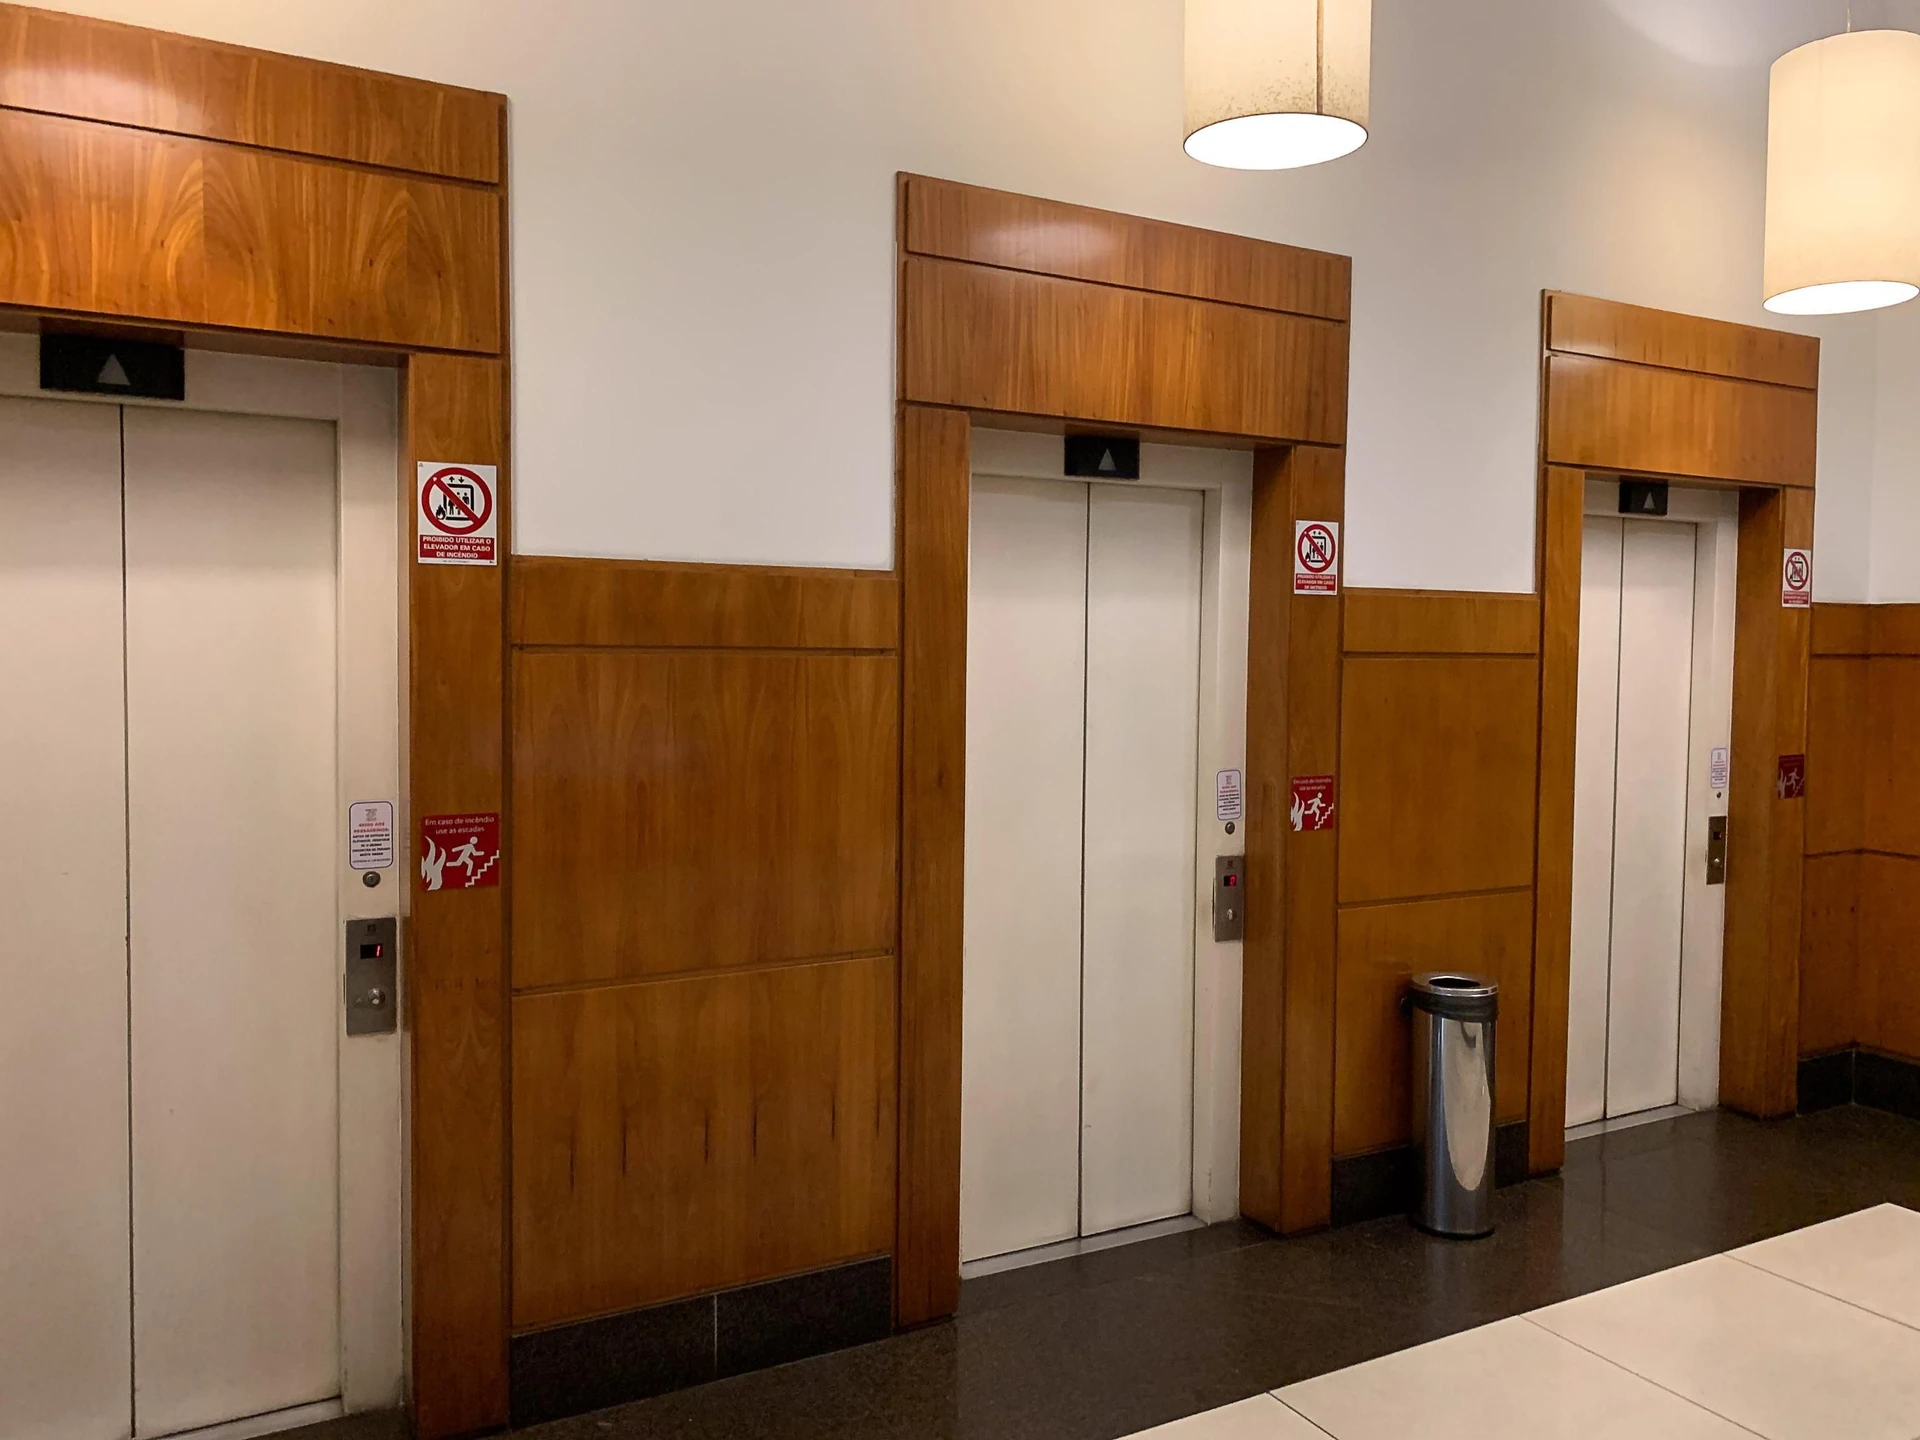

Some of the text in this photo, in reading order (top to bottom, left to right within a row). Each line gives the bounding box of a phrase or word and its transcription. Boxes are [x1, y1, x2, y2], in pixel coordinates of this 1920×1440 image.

[423, 543, 459, 551] ELEVADOR
[446, 551, 478, 559] INCÊNDIO
[425, 818, 437, 826] Em
[454, 817, 464, 825] de
[464, 816, 495, 824] incêndio
[457, 825, 485, 833] escadas
